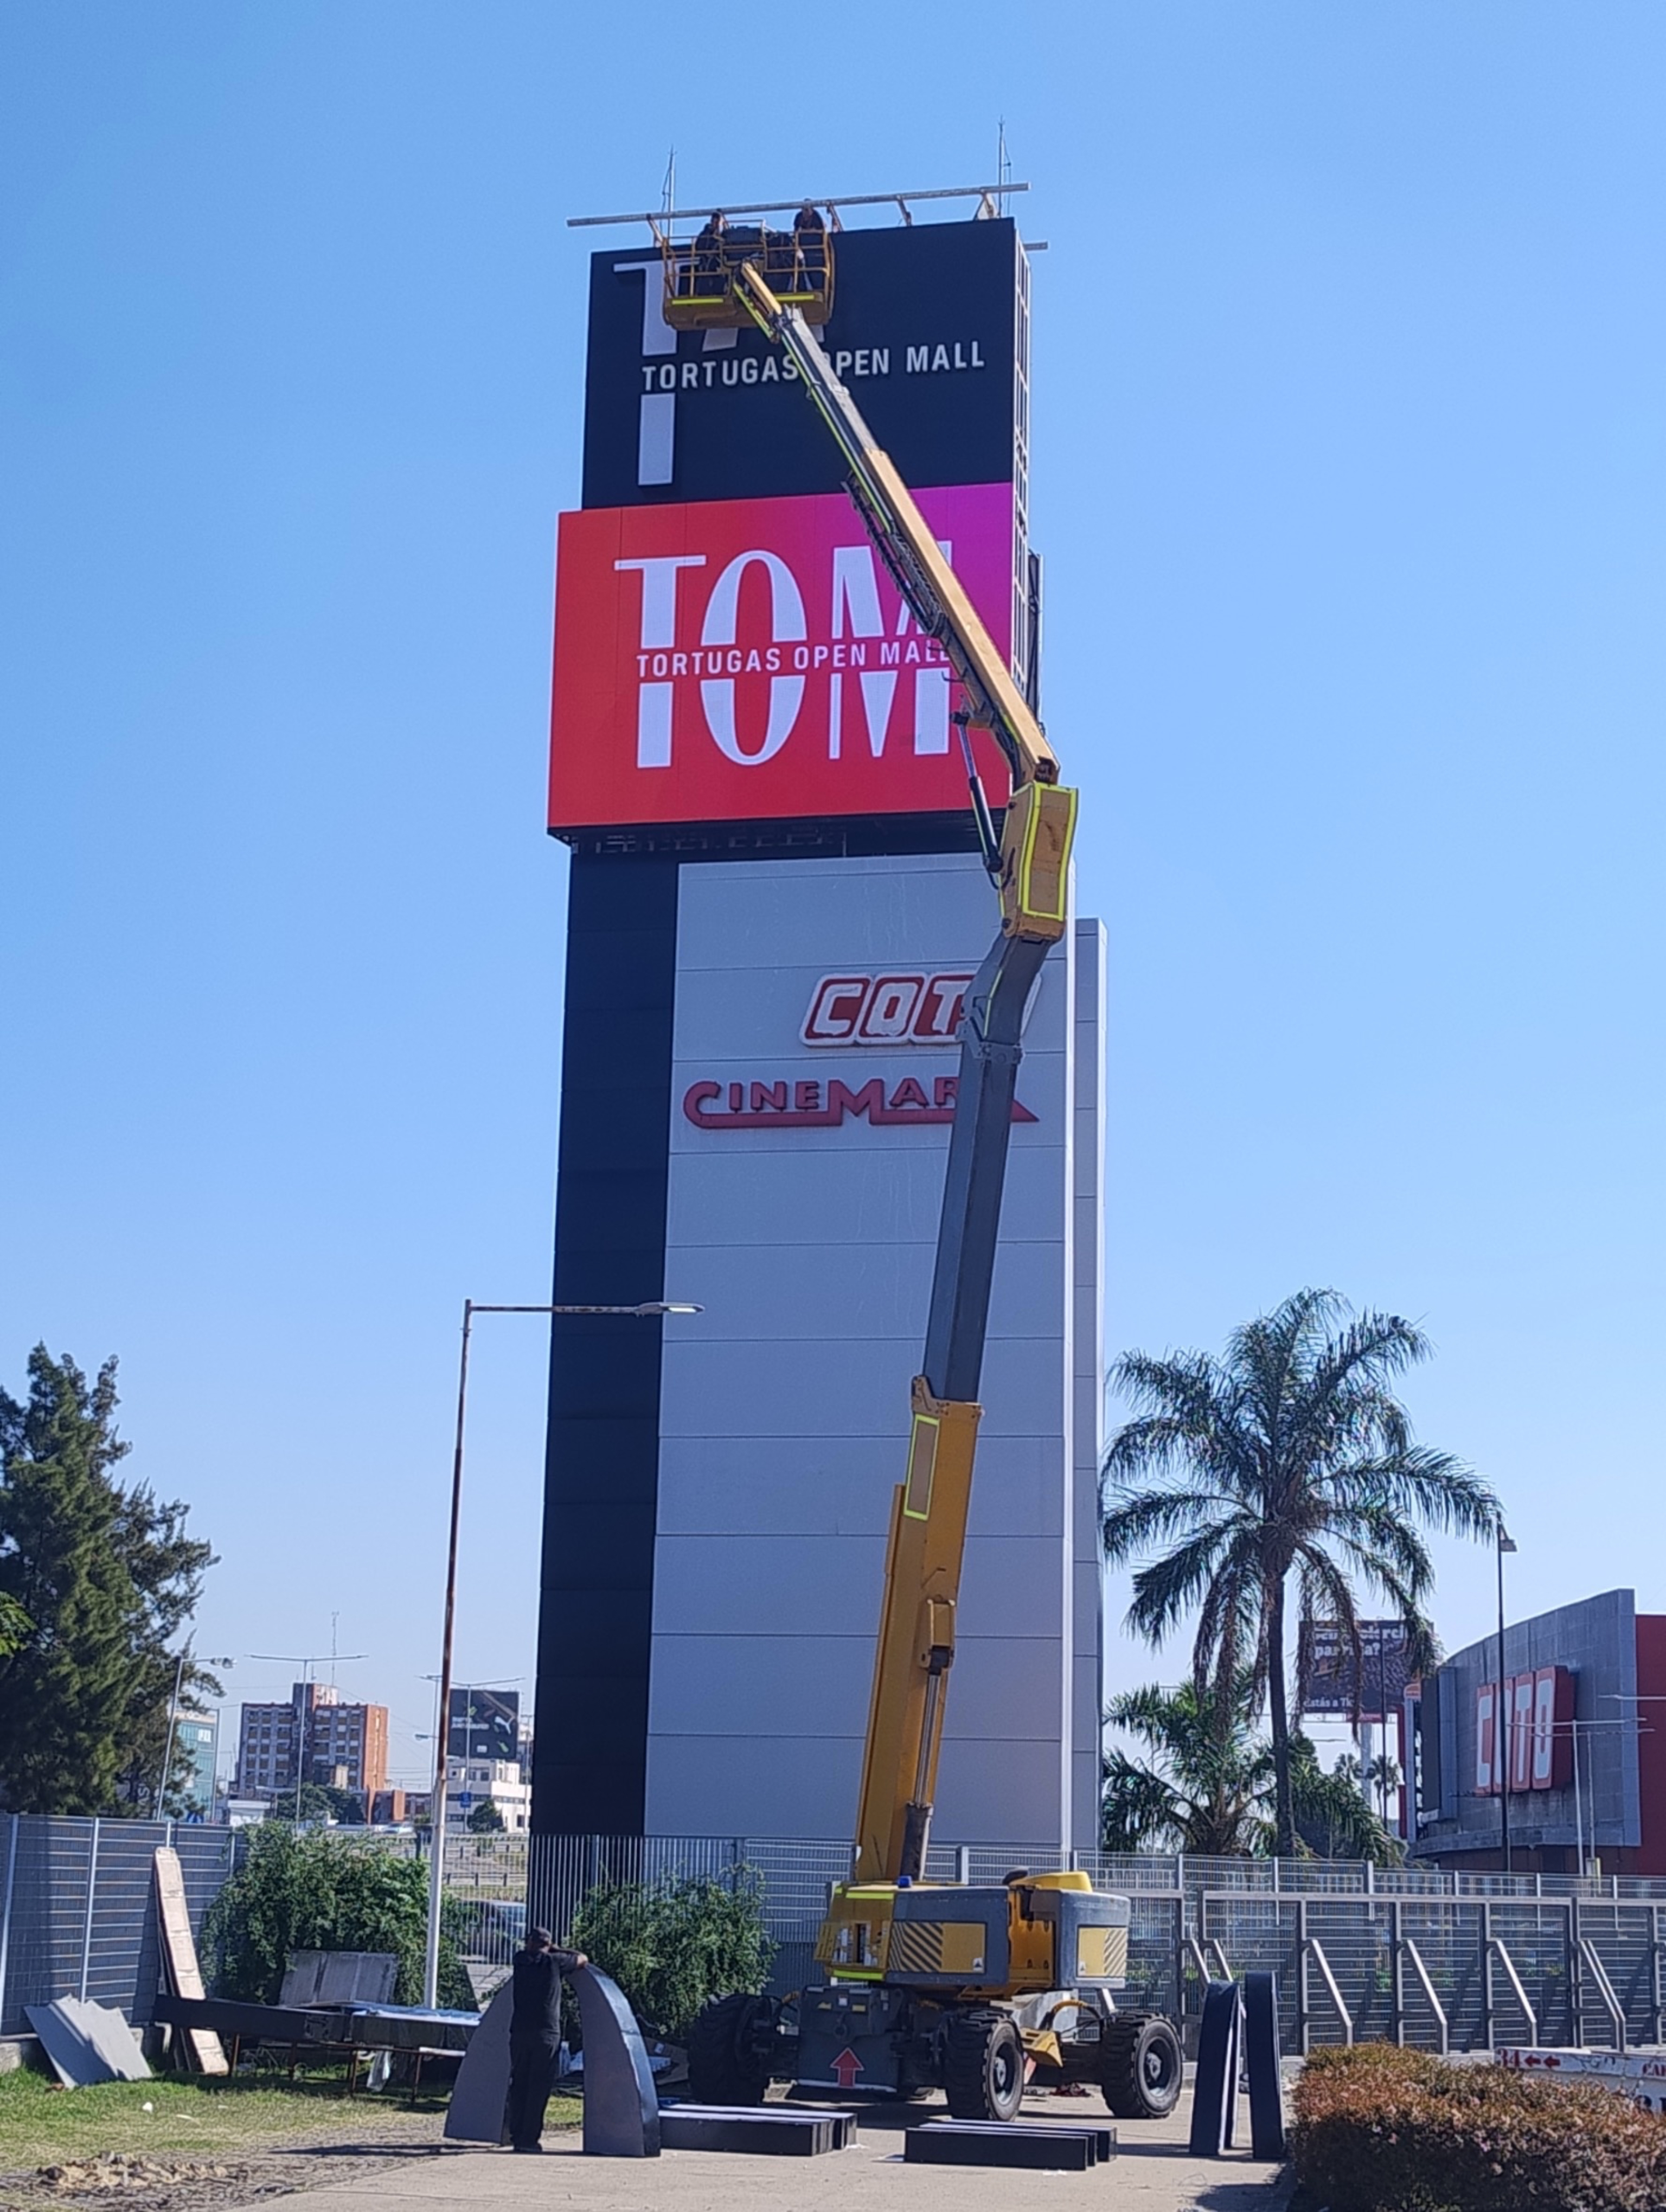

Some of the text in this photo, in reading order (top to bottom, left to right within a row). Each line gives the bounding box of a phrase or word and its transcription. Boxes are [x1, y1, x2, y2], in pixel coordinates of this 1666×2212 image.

[642, 340, 985, 391] TORTUGAS PEN MALL
[614, 541, 952, 769] TOM
[636, 647, 781, 678] TORTUGAS
[793, 643, 866, 670] OPEN
[800, 973, 1037, 1046] COT
[683, 1076, 1038, 1129] CINEMAR
[1476, 1674, 1554, 1789] COTO
